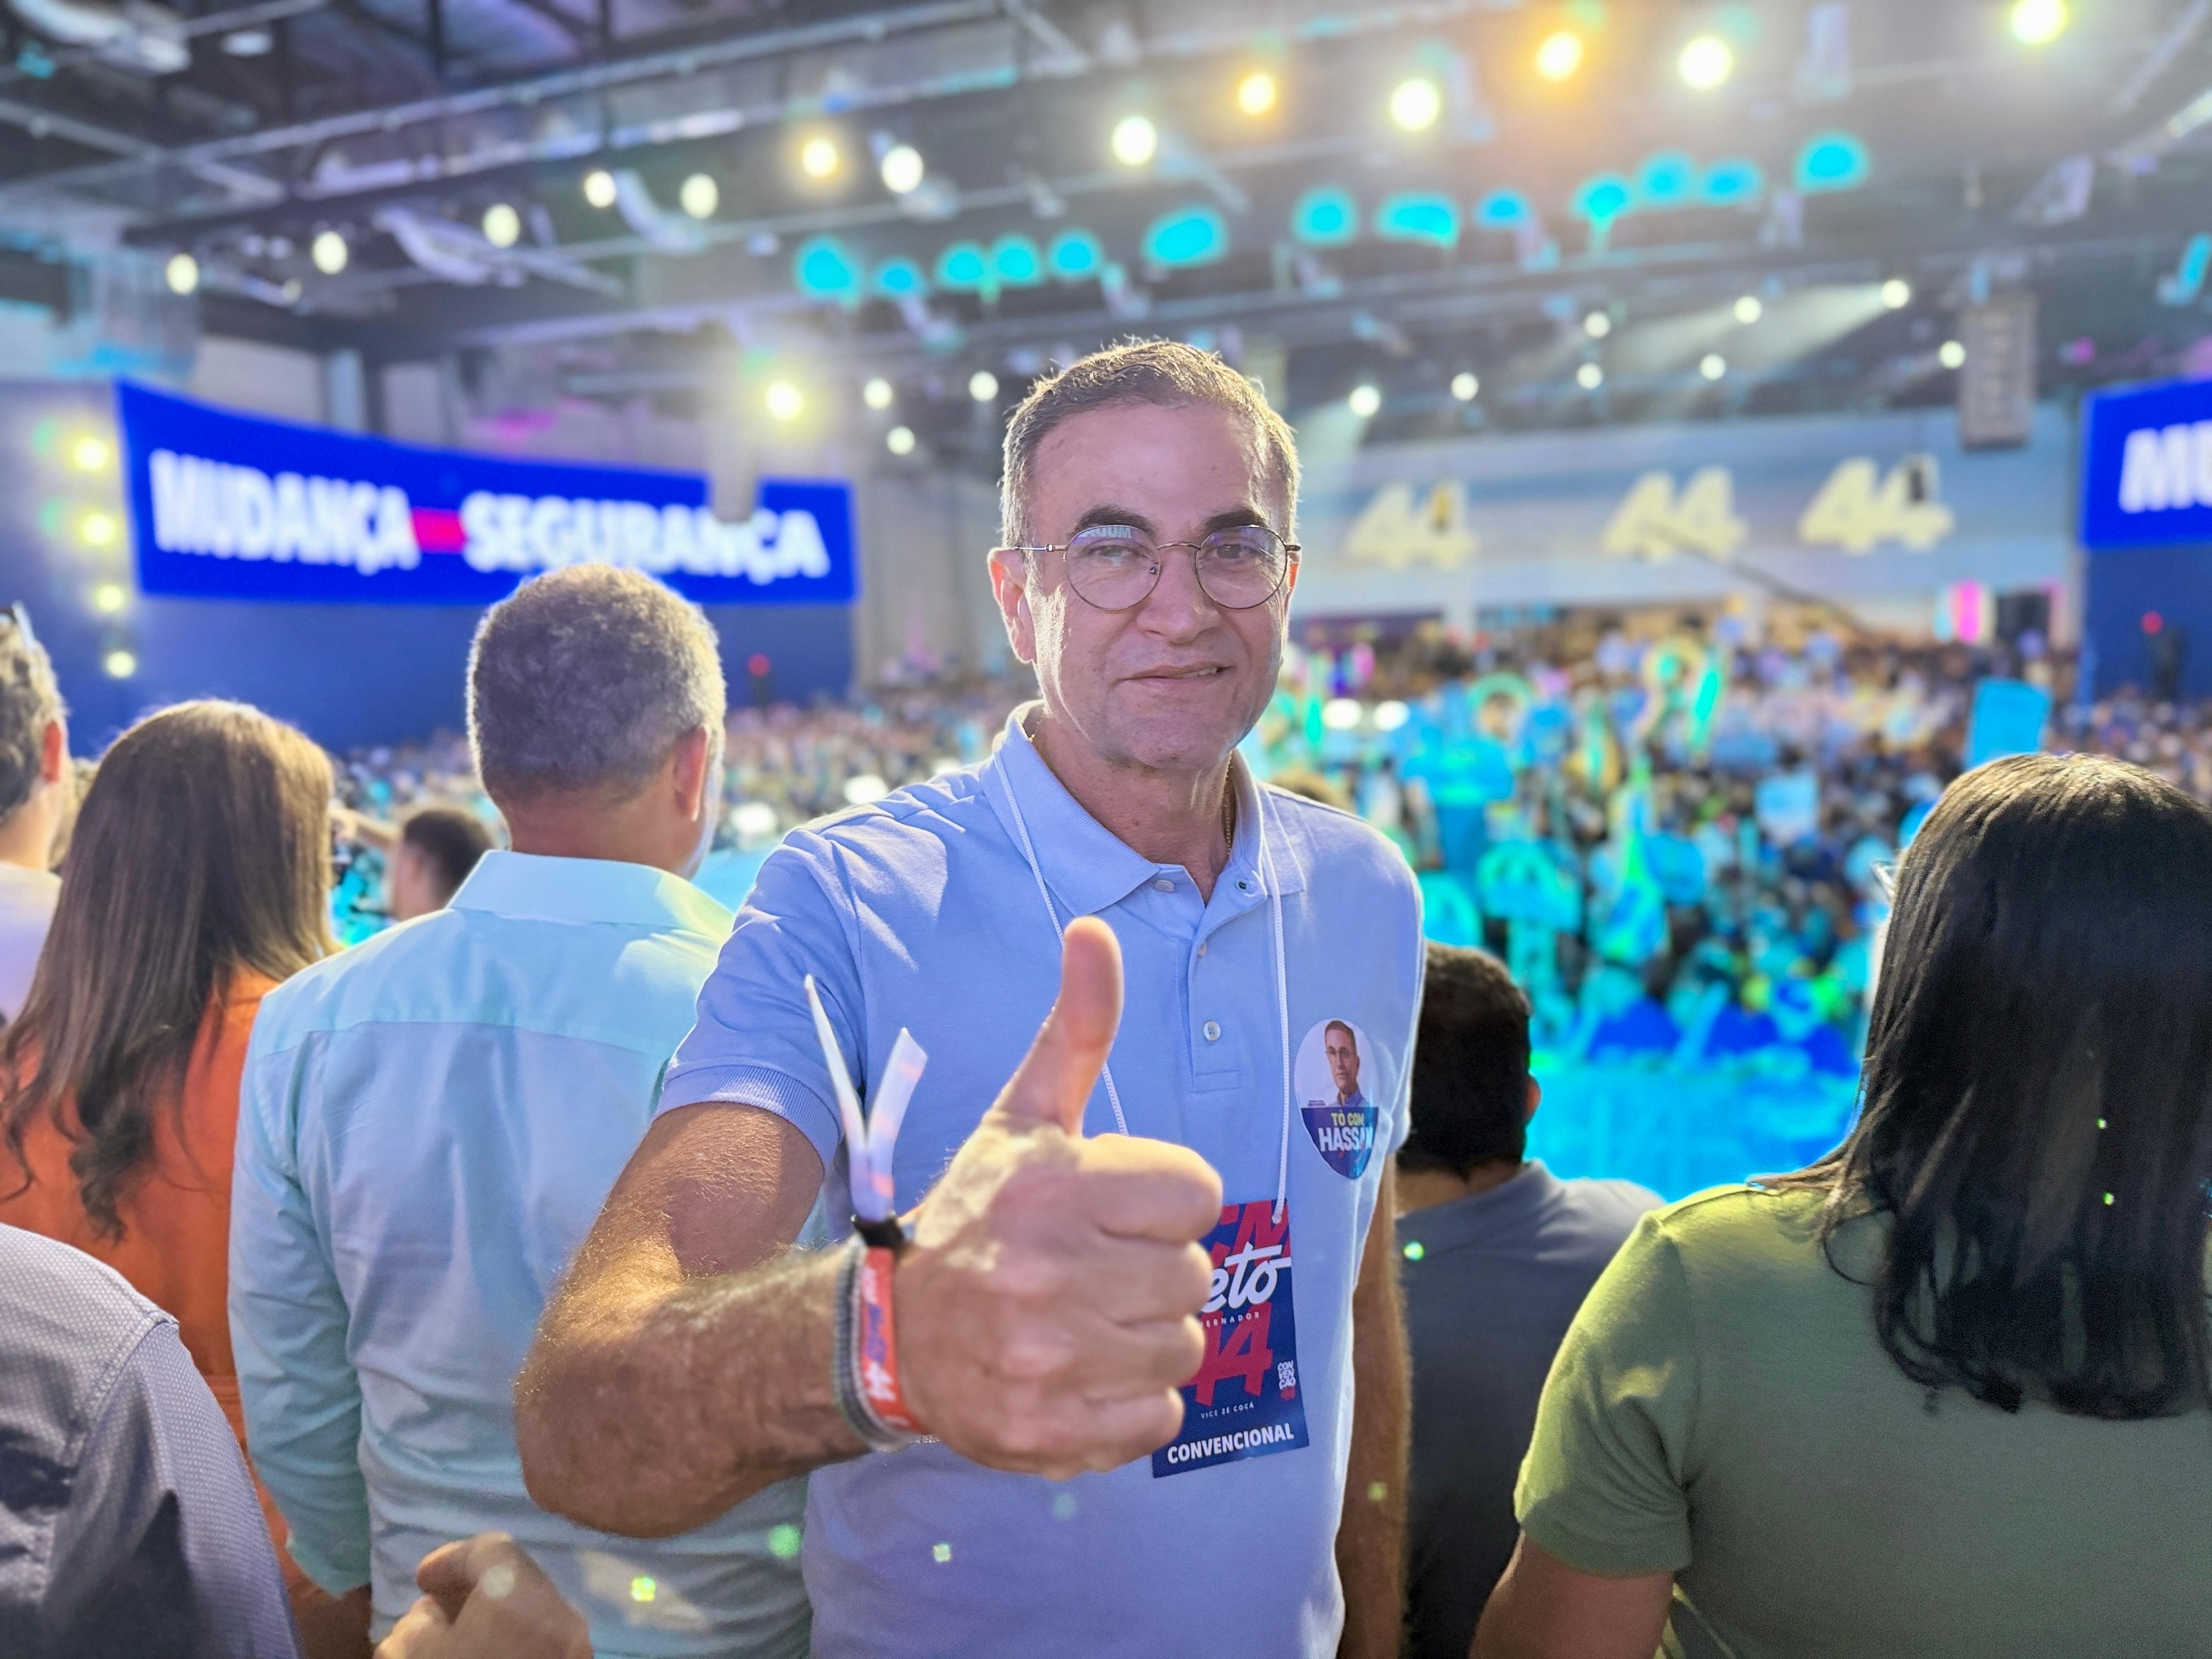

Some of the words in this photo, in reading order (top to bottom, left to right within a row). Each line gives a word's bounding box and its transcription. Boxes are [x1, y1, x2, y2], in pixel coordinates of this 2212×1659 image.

[149, 448, 422, 575] MUDANÇA
[461, 490, 831, 585] SEGURANÇA
[1201, 1242, 1292, 1313] eto
[1200, 1311, 1260, 1328] ERNADOR
[1167, 1423, 1295, 1464] CONVENCIONAL
